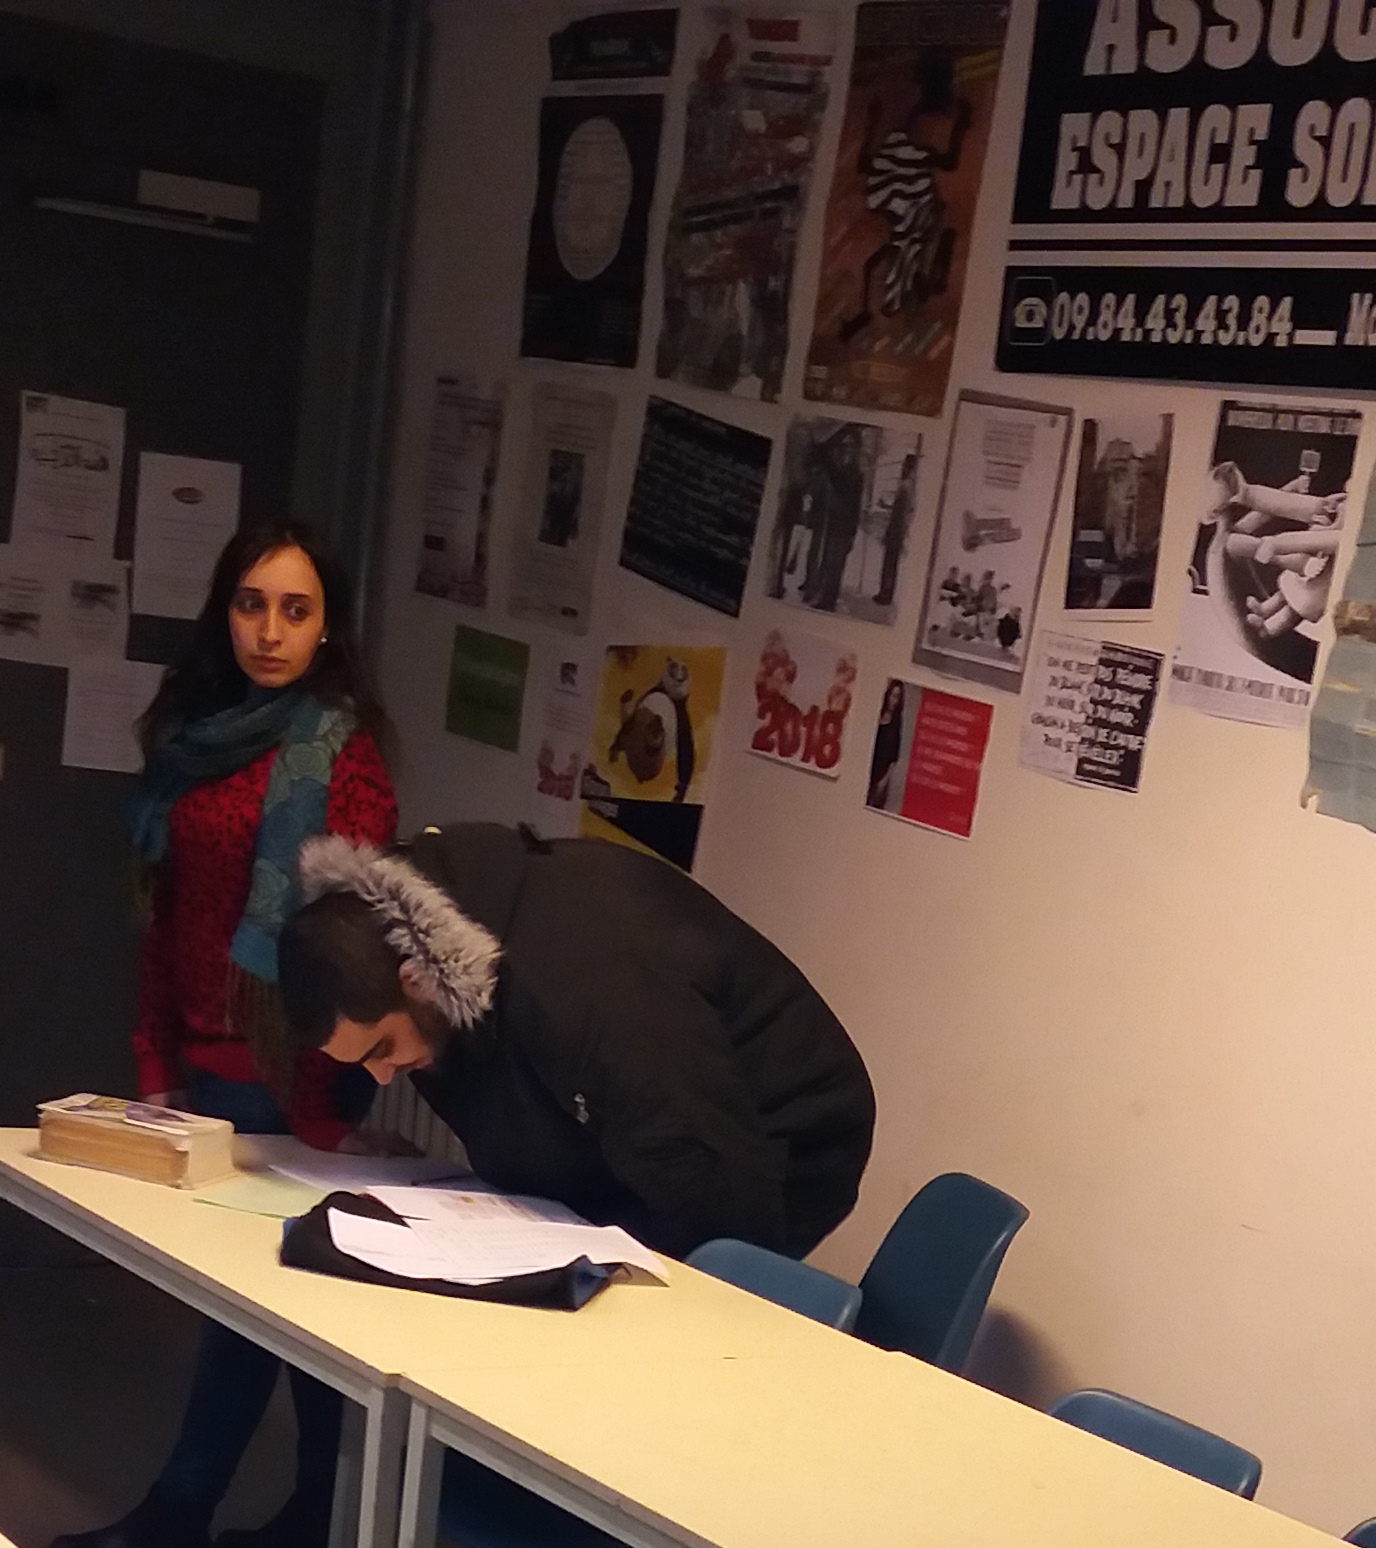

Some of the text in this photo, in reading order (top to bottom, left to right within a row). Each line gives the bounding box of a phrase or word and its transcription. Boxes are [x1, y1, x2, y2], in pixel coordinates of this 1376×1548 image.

[1050, 103, 1273, 210] ESPACE
[1052, 290, 1294, 347] 09.84.43.43.84
[751, 700, 841, 770] 2018
